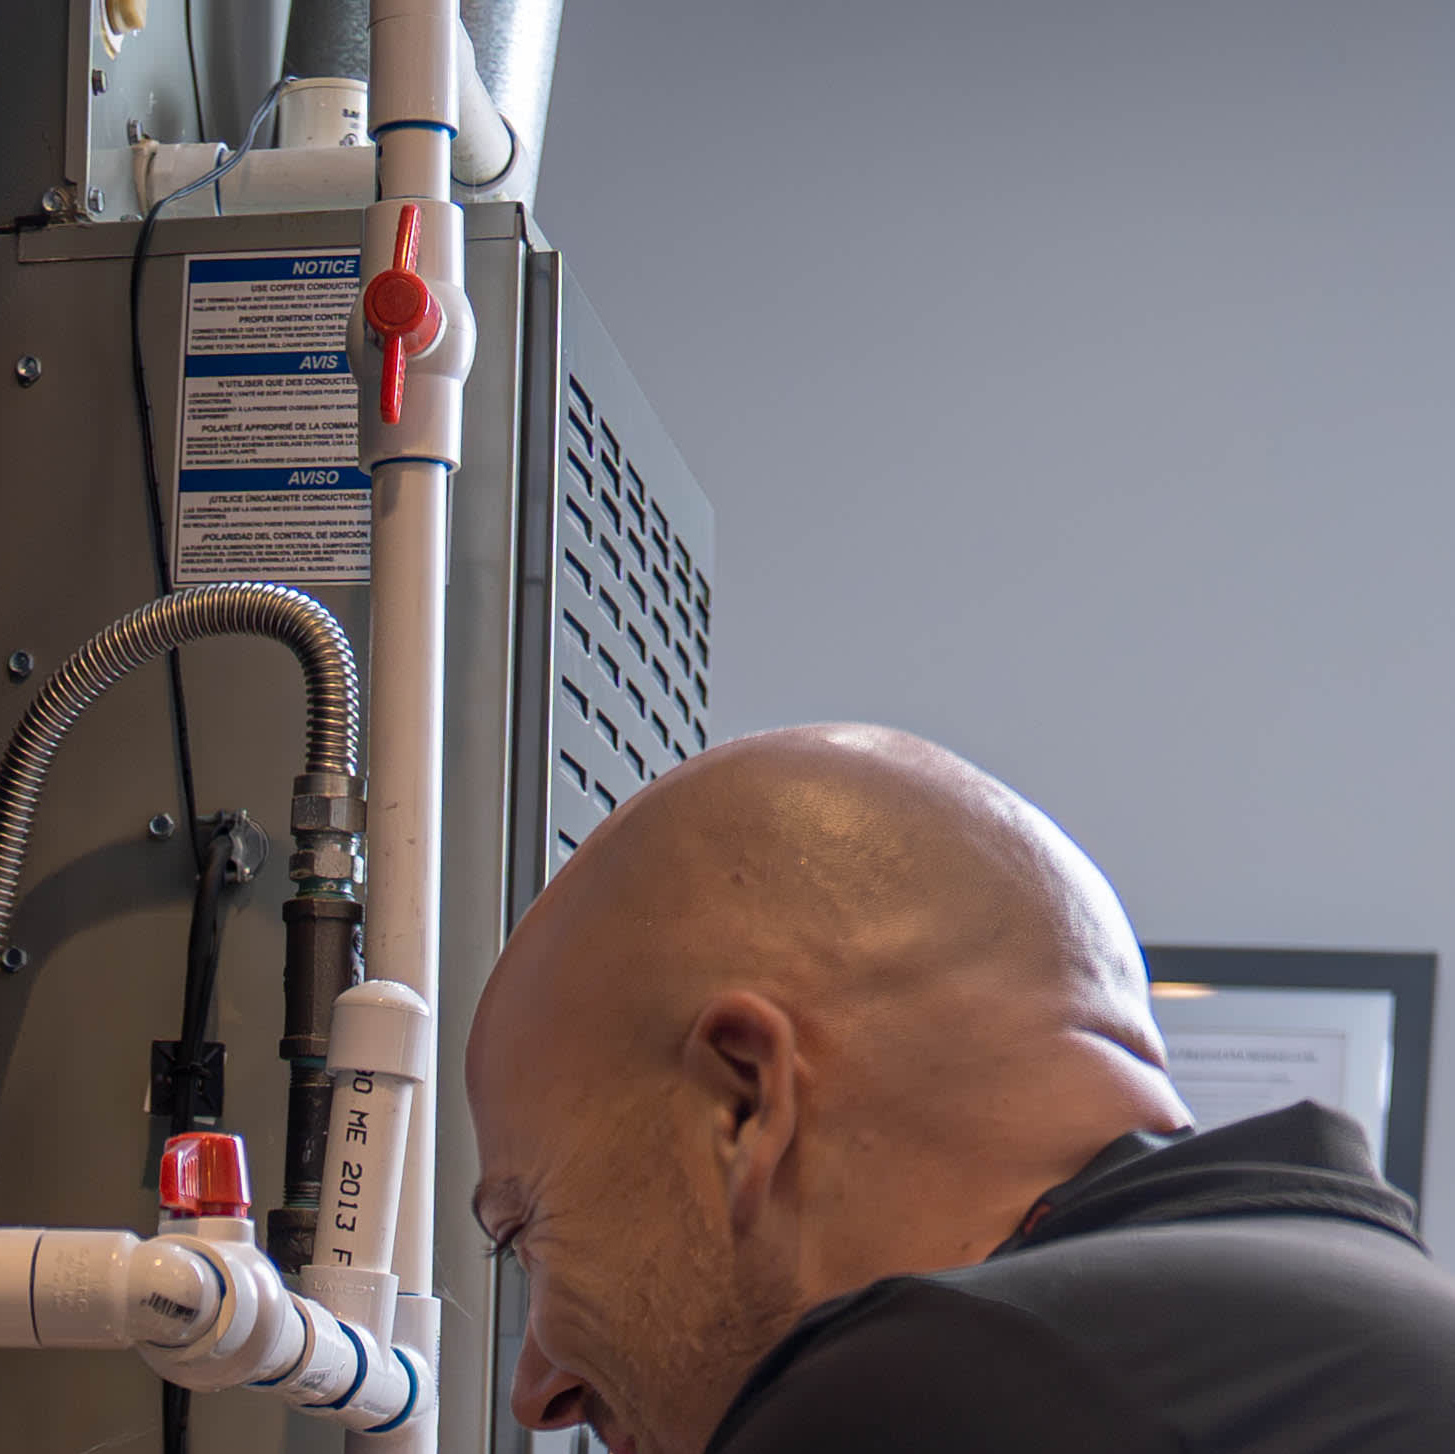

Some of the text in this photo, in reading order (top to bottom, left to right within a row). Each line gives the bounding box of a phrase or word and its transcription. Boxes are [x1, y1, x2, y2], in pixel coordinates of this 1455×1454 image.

[292, 259, 357, 275] NOTICE
[251, 284, 268, 292] USE
[270, 283, 306, 292] COPPER
[239, 315, 274, 324] PROPER
[299, 355, 339, 370] AVIS
[265, 379, 283, 387] QUE
[202, 423, 242, 432] POLARITÉ
[295, 422, 307, 430] DE
[309, 422, 320, 430] LA
[288, 470, 339, 485] AVISO
[303, 492, 367, 502] CONDUCTORES
[254, 532, 271, 540] DEL
[273, 531, 314, 540] CONTROL
[316, 531, 328, 539] DE
[346, 1109, 370, 1146] ME
[335, 1161, 363, 1233] 2013
